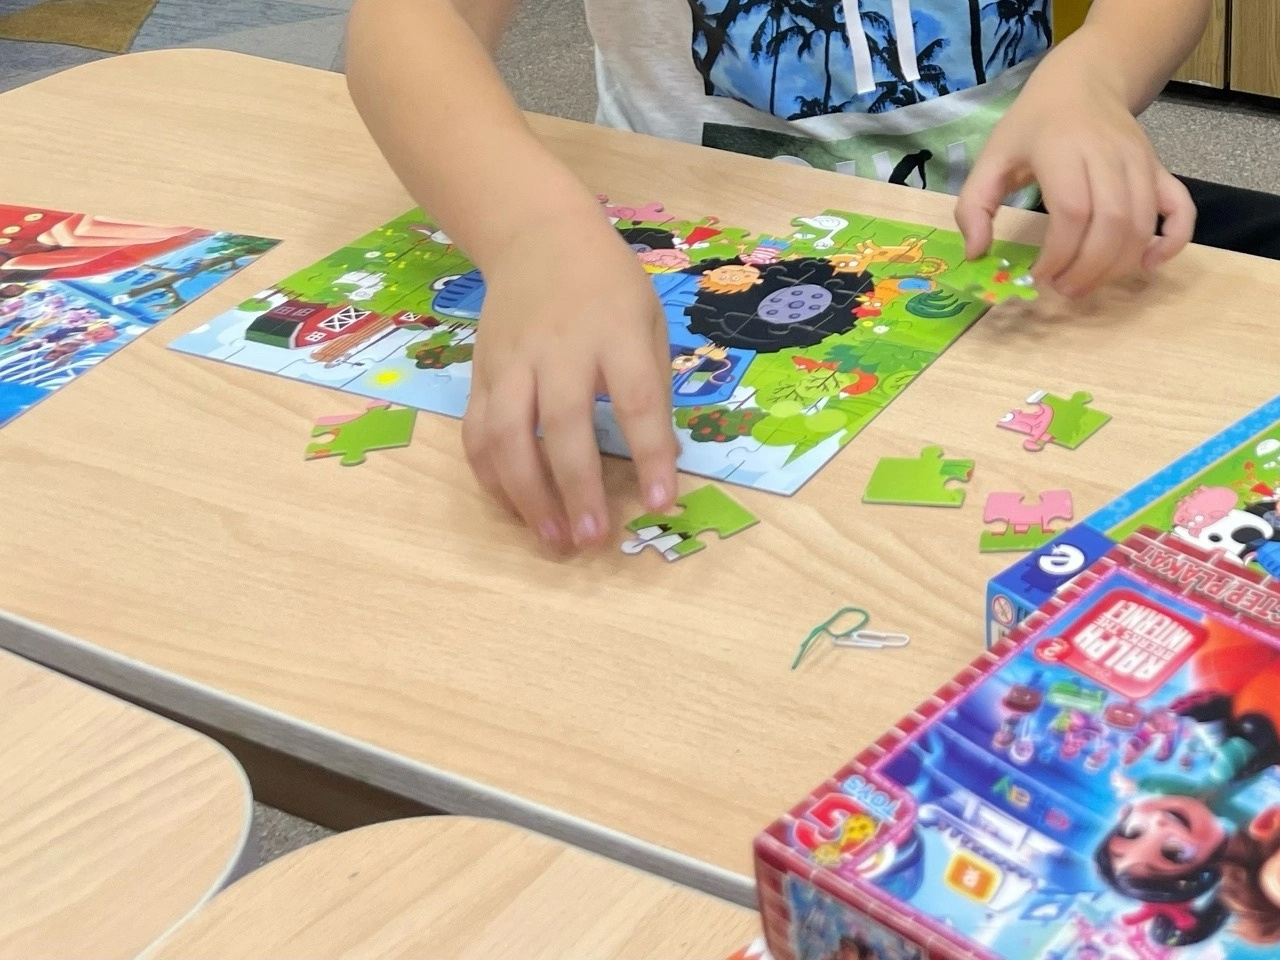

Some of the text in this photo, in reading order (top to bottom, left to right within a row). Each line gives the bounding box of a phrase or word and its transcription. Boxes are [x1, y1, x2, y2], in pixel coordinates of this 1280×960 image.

[1073, 622, 1167, 680] RALPH
[1103, 599, 1194, 653] INTERNET
[841, 773, 903, 823] TOYS
